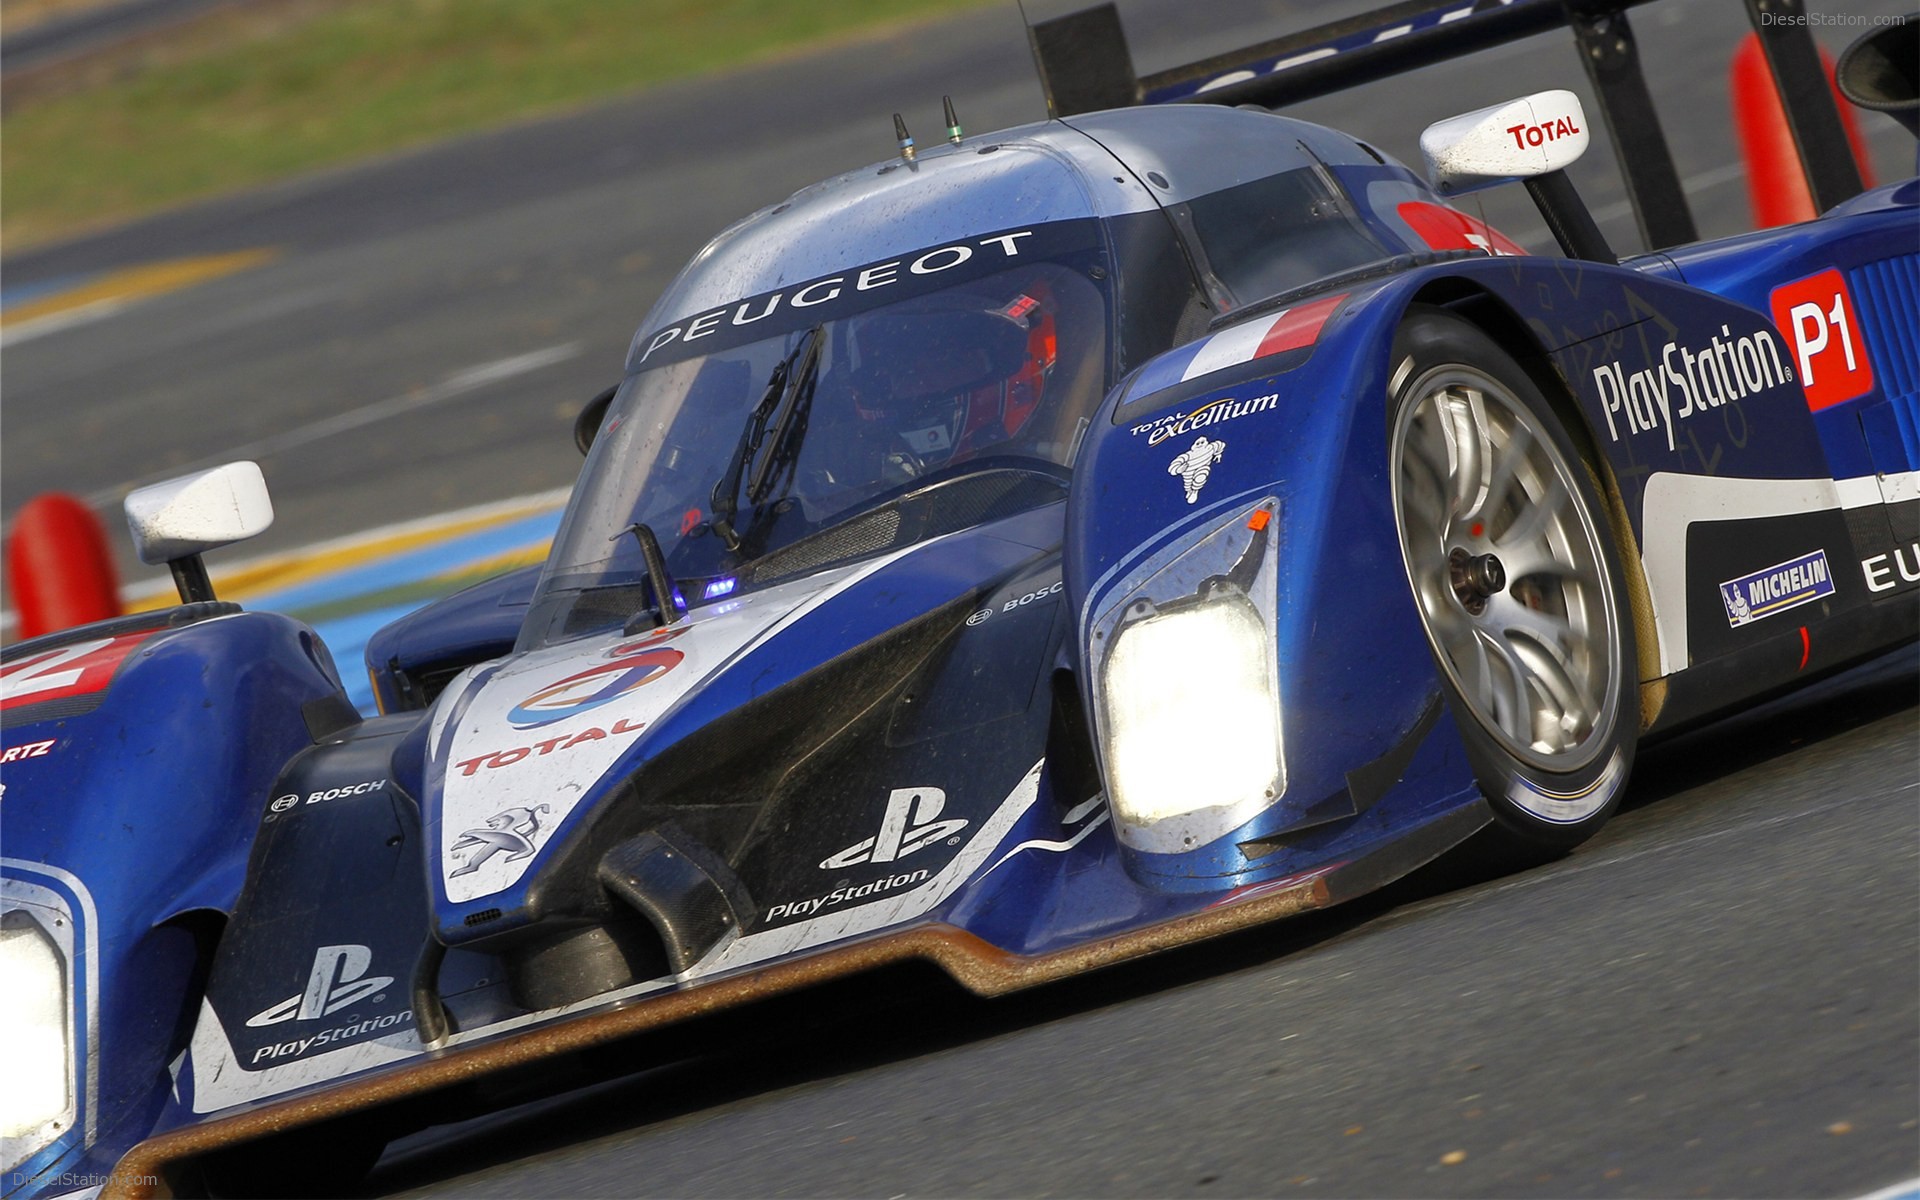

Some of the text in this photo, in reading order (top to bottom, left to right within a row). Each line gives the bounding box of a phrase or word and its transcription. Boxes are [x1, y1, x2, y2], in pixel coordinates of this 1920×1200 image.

[640, 231, 1033, 364] PEUGEOT
[1790, 293, 1857, 387] P1
[1593, 324, 1786, 451] PlayStation
[1130, 412, 1187, 436] TOTAL
[1148, 393, 1279, 445] excellium
[1749, 558, 1827, 606] MICHELIN
[1861, 543, 1920, 592] EU
[1003, 581, 1063, 612] BOSC
[455, 719, 647, 776] TOTAL
[306, 779, 387, 805] BOSCH
[765, 869, 928, 923] PlayStation
[252, 1010, 413, 1064] PlayStation
